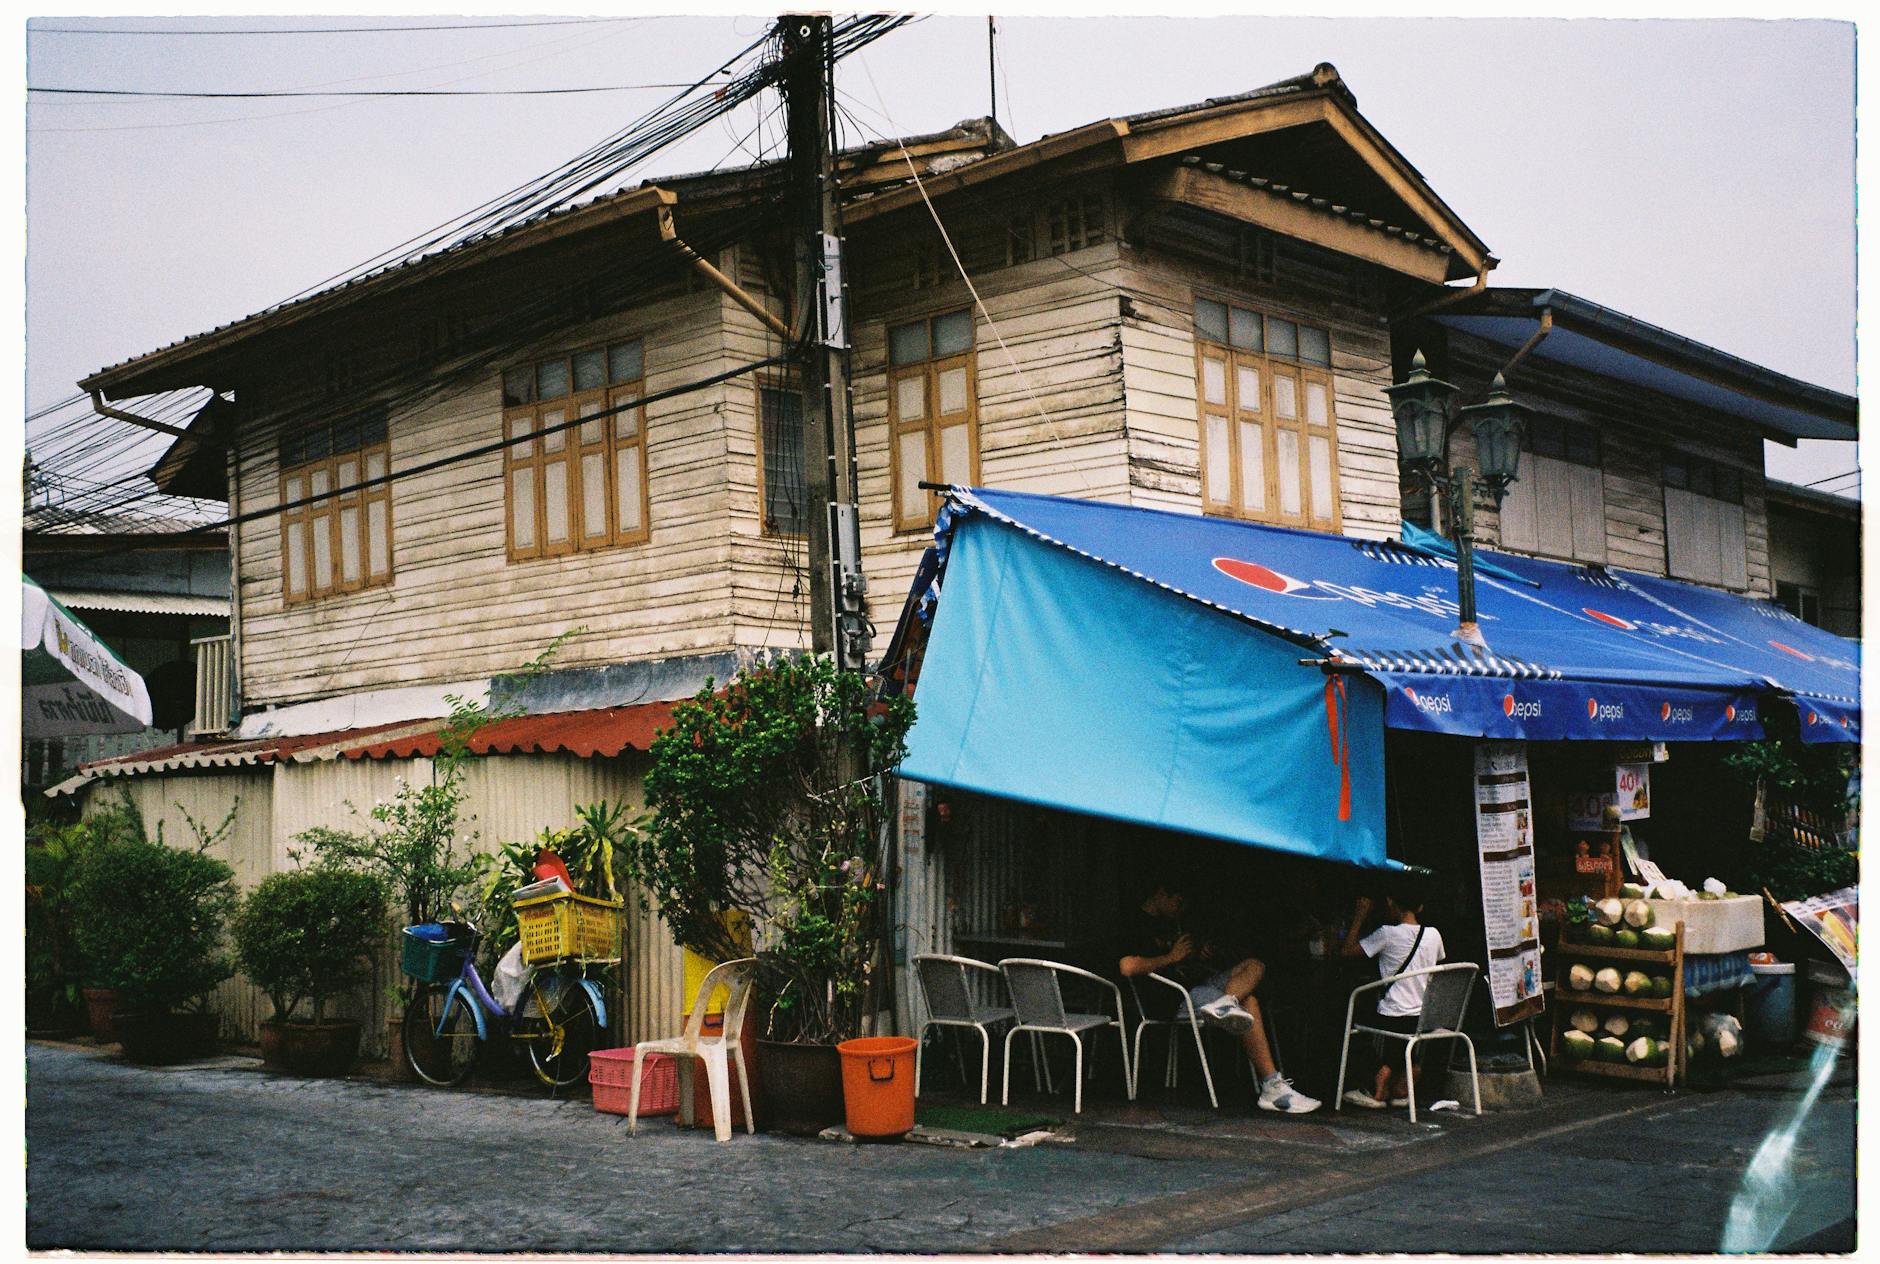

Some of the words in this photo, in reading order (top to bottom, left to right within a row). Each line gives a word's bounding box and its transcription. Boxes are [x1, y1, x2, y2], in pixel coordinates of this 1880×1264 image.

[1420, 694, 1452, 716] pepsi
[1599, 702, 1624, 722] pepsi
[1671, 705, 1693, 723] pepsi
[1735, 707, 1756, 723] pepsi
